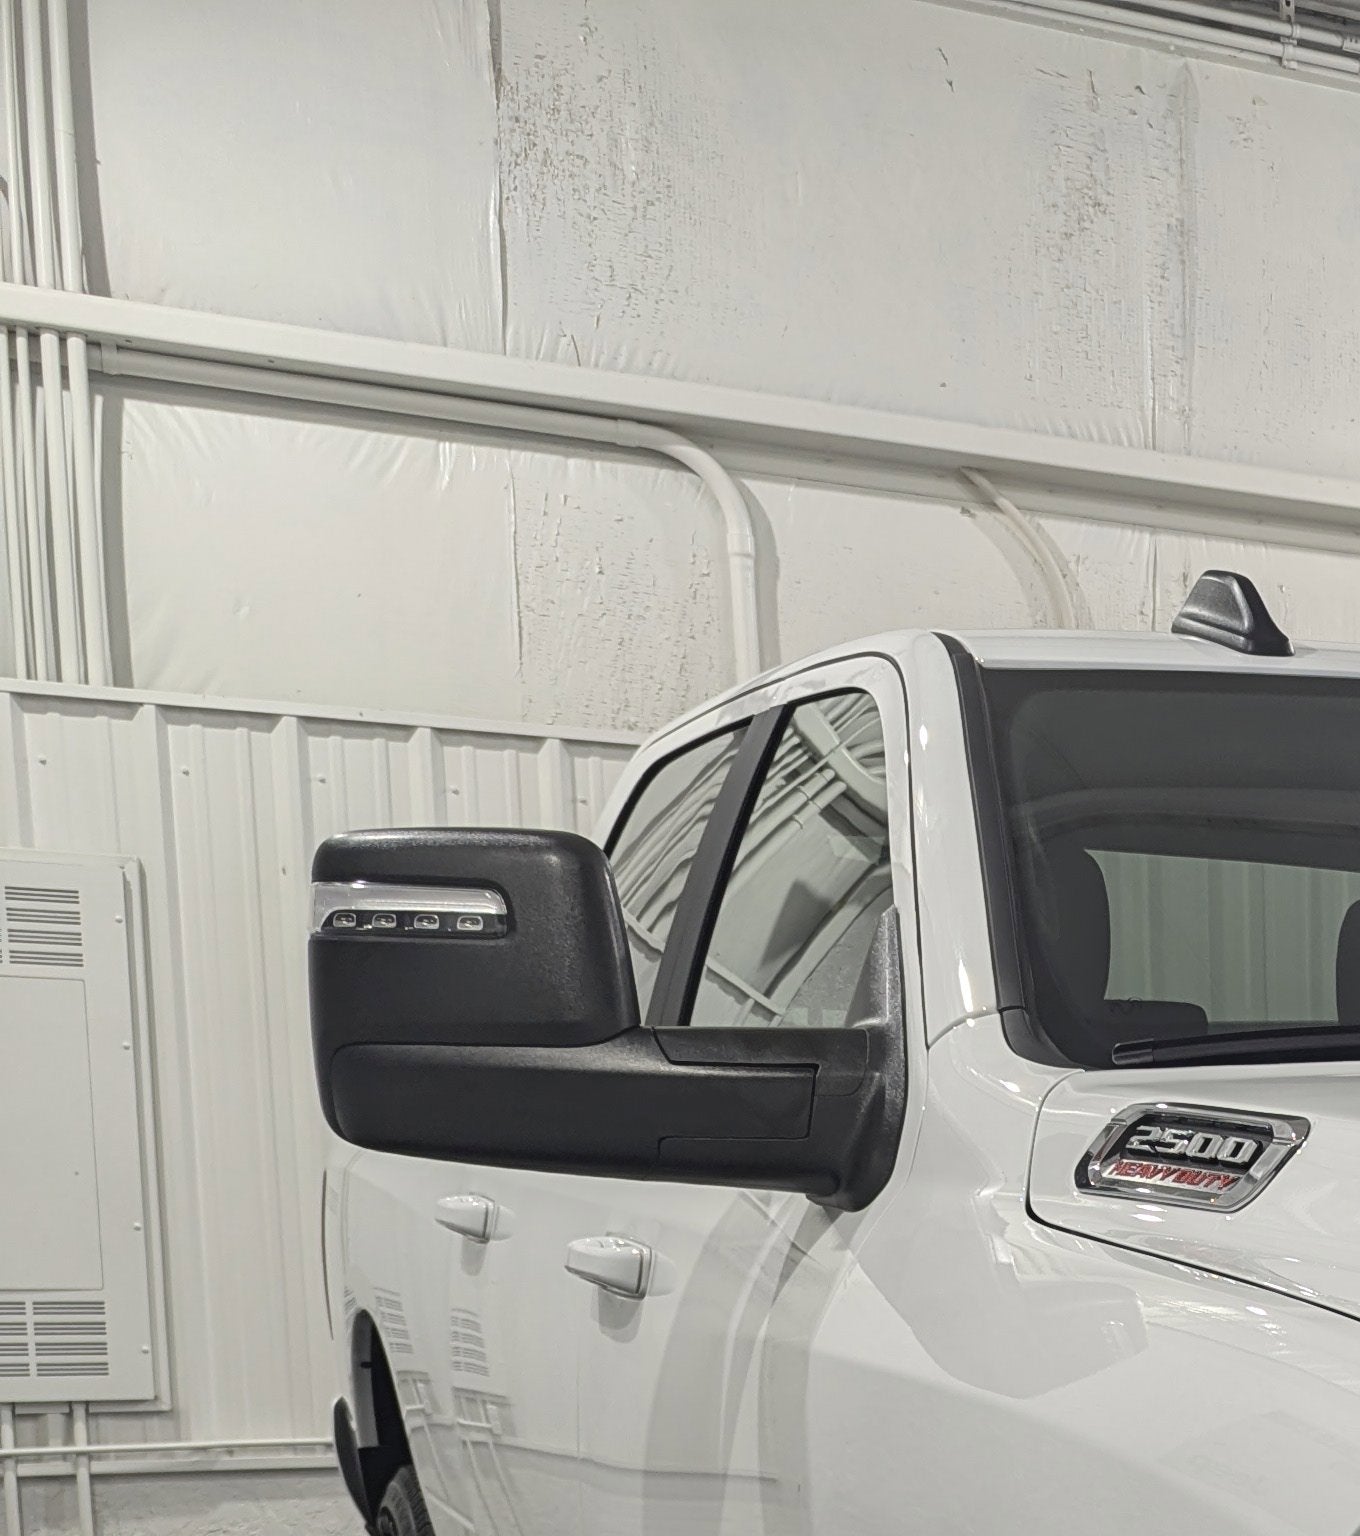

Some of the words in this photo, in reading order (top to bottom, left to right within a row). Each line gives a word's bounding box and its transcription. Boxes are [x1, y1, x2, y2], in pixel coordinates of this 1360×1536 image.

[1125, 1125, 1259, 1165] 2500
[1110, 1160, 1178, 1182] HEAVY
[1173, 1168, 1240, 1190] DUTY
